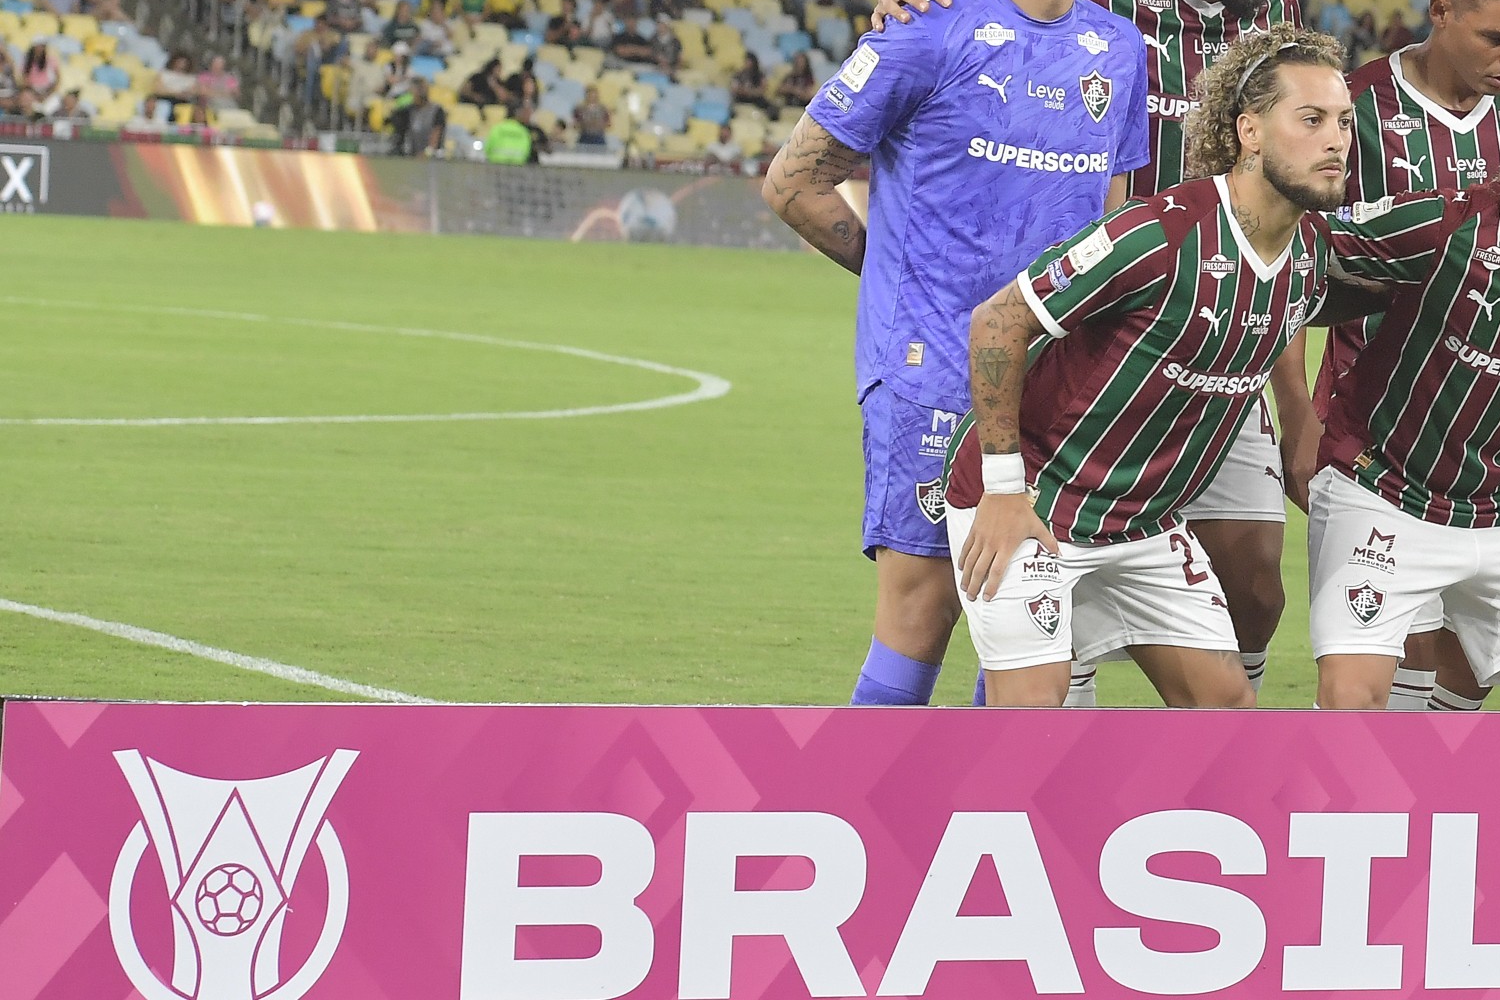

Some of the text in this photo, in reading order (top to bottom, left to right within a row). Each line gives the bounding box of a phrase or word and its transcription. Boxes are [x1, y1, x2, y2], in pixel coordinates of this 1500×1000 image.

[975, 29, 1014, 40] FRESCATTO
[1079, 35, 1108, 50] FRESCATTO
[1194, 38, 1229, 55] Leve
[1027, 80, 1066, 100] Leve
[1044, 99, 1065, 111] saúde
[1384, 119, 1421, 130] FRESCATTO
[968, 137, 1109, 174] SUPERSCORE
[1447, 156, 1487, 172] Leve
[1467, 170, 1488, 179] saúde
[1203, 262, 1235, 272] FRESCATTO
[1295, 258, 1314, 271] FRESCATTO
[1241, 310, 1272, 327] Leve
[1251, 326, 1269, 335] saúde
[1162, 362, 1271, 395] SUPERSCOR
[921, 434, 950, 448] MEG
[1353, 546, 1396, 567] MEGA
[1023, 561, 1060, 575] MEGA
